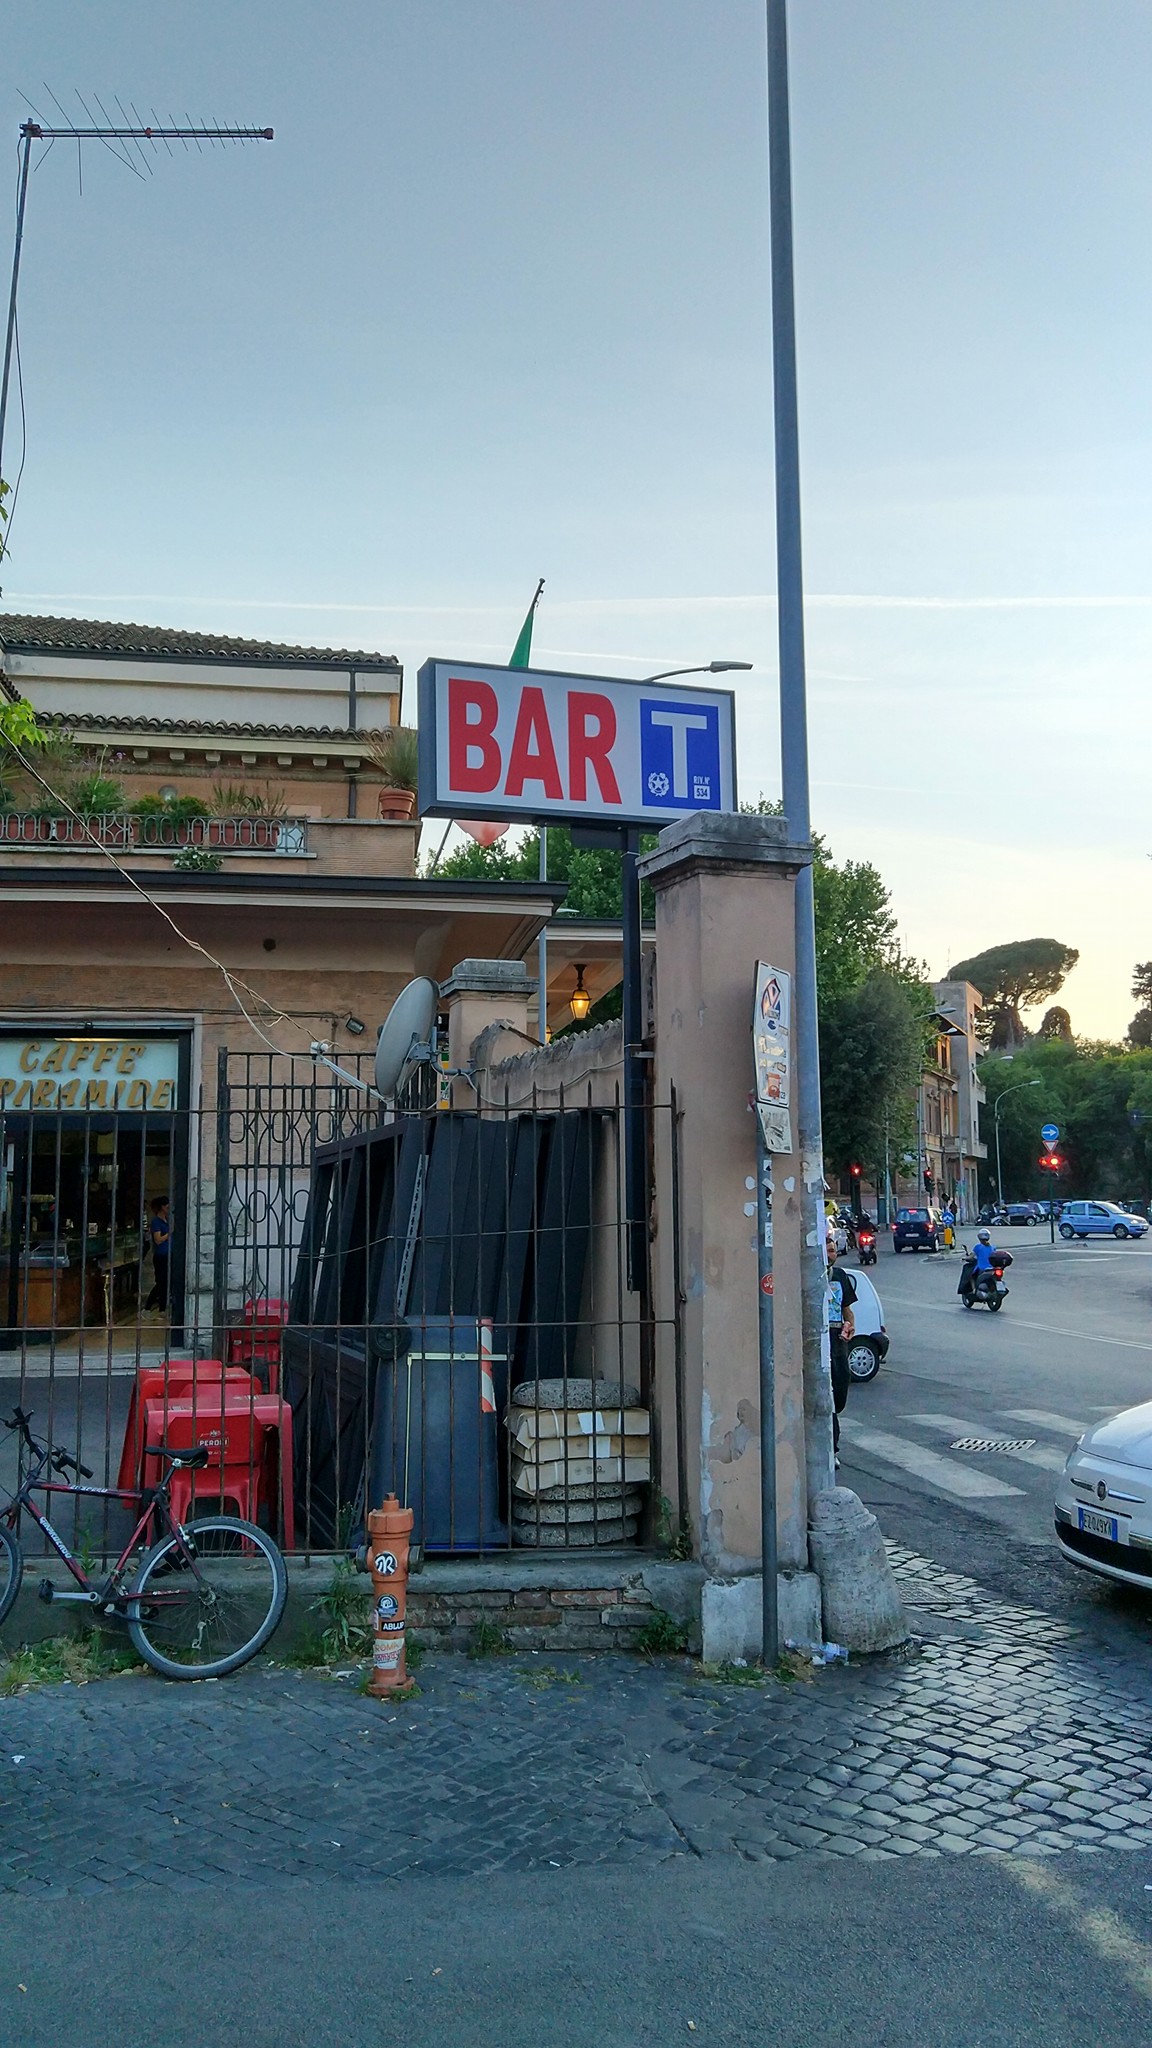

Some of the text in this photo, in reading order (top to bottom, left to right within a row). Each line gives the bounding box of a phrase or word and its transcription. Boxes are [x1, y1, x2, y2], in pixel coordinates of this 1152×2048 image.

[448, 678, 623, 804] BAR
[651, 710, 707, 799] T
[696, 787, 708, 797] 534
[0, 1078, 175, 1108] PIRAMIDE
